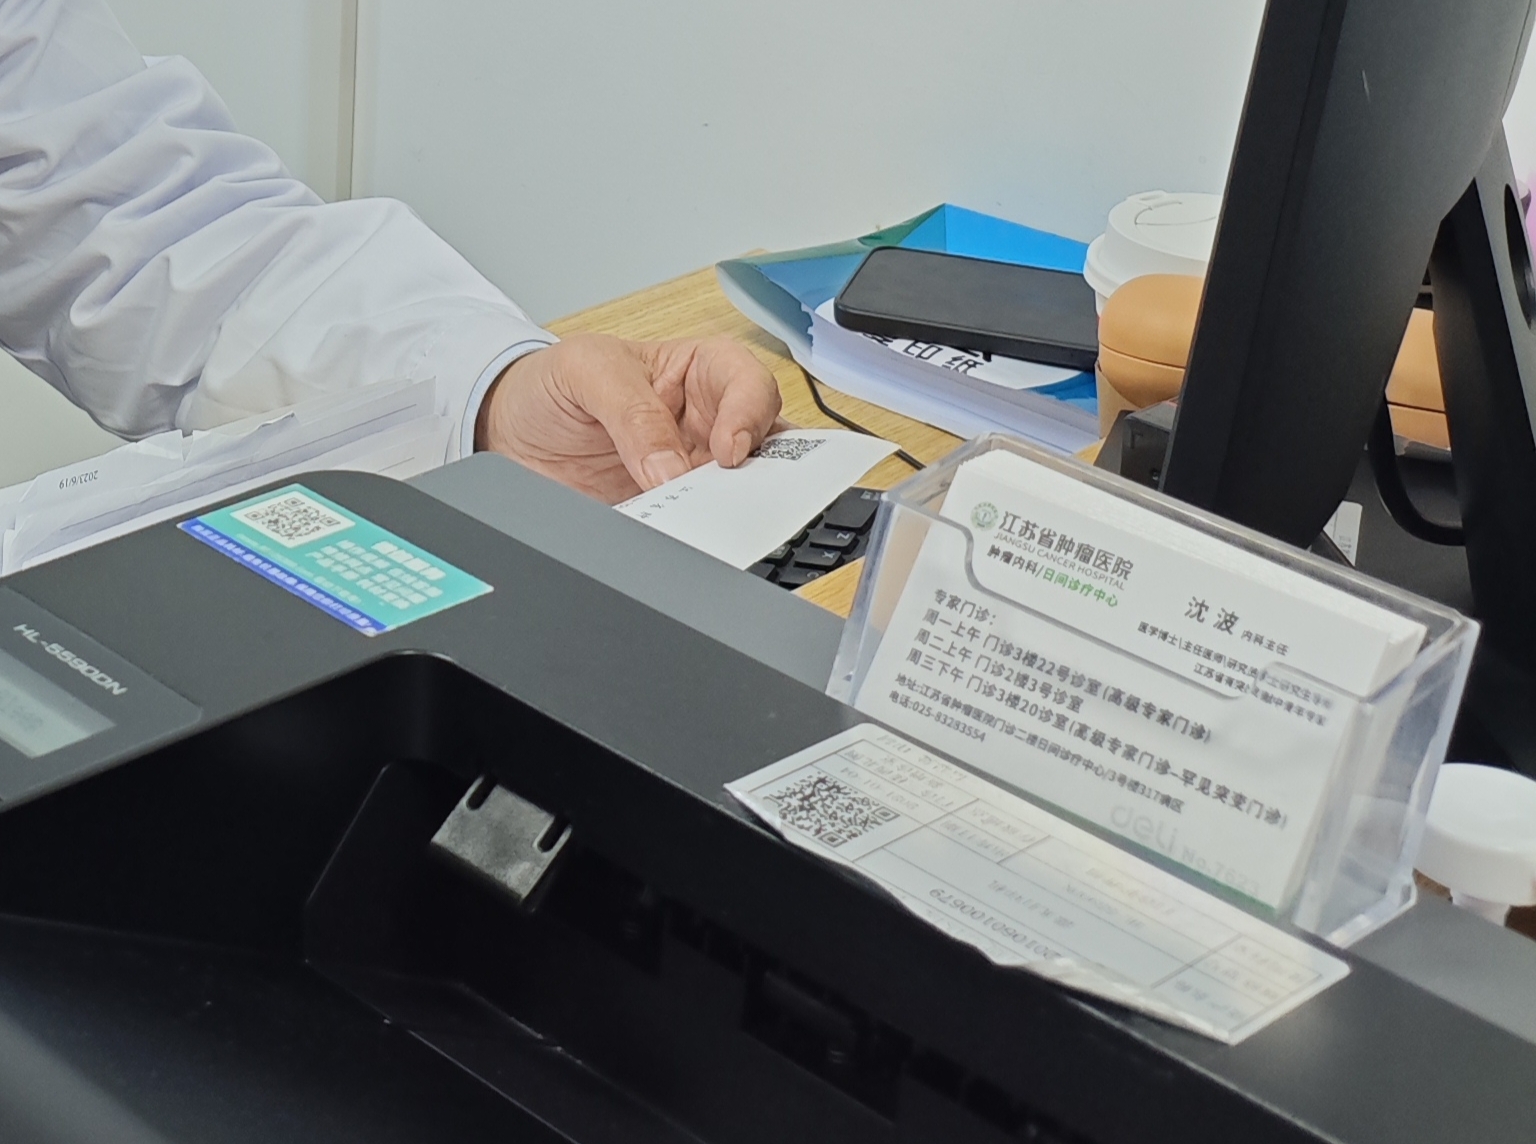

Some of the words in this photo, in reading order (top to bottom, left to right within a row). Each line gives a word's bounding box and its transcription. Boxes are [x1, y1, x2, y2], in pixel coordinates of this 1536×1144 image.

[59, 470, 98, 489] 2023/6/19
[993, 530, 1036, 555] JIANGSU
[1036, 547, 1077, 571] CANCER
[1076, 563, 1126, 591] HOSPITAL
[998, 509, 1135, 582] 江苏省肿瘤医院
[921, 607, 982, 644] 周一上午
[13, 622, 129, 696] HL-5590DN
[904, 647, 966, 685] 周三下午
[913, 626, 974, 664] 周二上午
[973, 653, 1084, 714] 门诊2楼3号诊室
